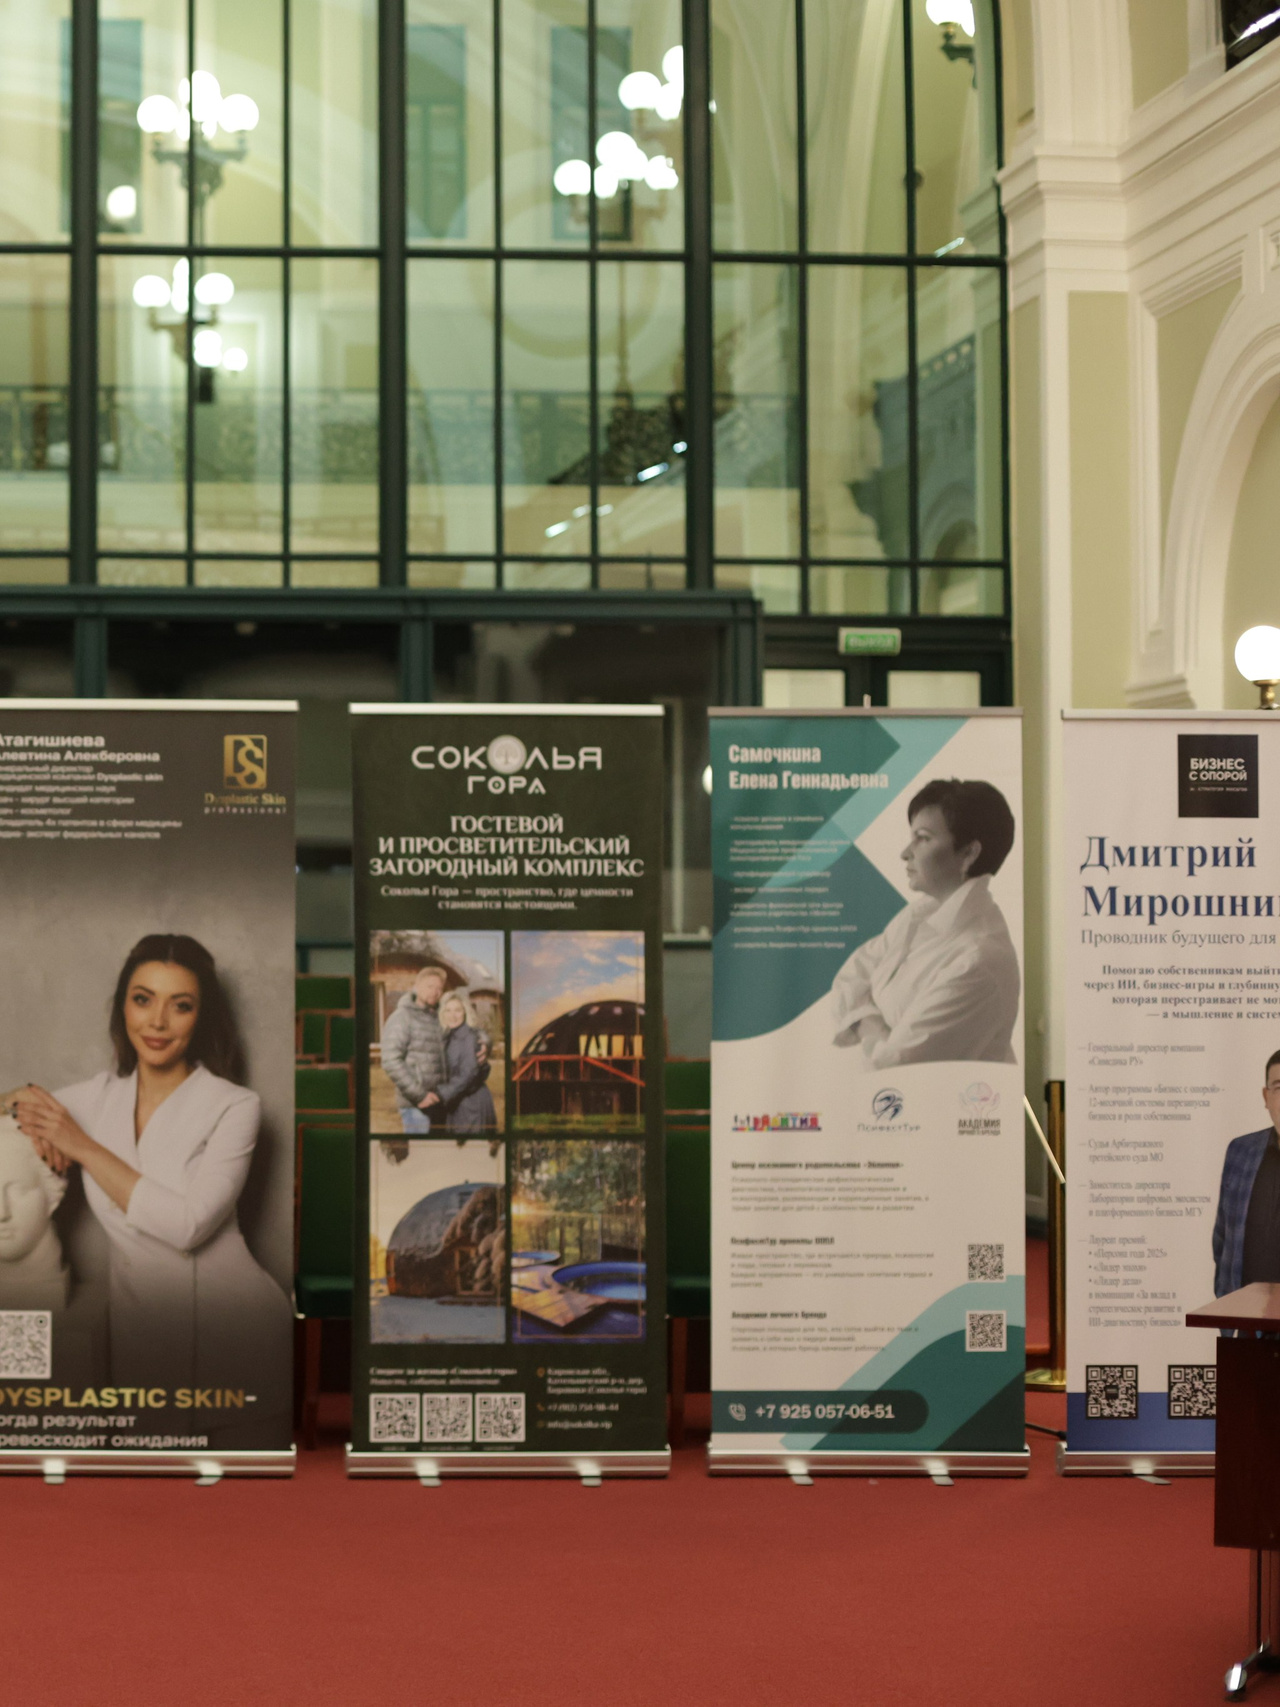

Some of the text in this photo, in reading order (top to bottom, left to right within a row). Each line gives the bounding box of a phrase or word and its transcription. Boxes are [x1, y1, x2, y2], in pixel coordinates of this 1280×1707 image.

[64, 749, 161, 764] Алекберовна
[728, 744, 822, 764] Самочкина
[1190, 757, 1246, 770] БИЗНЕС
[729, 770, 889, 790] Елена Геннадьевна
[1189, 770, 1248, 781] С ОПОРОЙ
[467, 776, 547, 795] ГОРА
[204, 806, 286, 814] professional
[450, 814, 564, 834] ГОСТЕВОЙ
[378, 835, 630, 855] И ПРОСВЕТИТЕЛЬСКИЙ
[1080, 836, 1257, 876] Дмитрий
[369, 857, 645, 878] ЗАГОРОДНЫЙ КОМПЛЕКС
[381, 886, 430, 897] Соколья
[432, 886, 459, 898] Гора
[475, 886, 556, 898] пространство,
[558, 886, 578, 898] где
[580, 886, 633, 898] ценности
[1083, 886, 1280, 926] Мирошни
[1081, 929, 1276, 948] Проводник будущего для
[1102, 965, 1155, 976] Помогаю
[1157, 965, 1243, 976] собственникам
[1084, 982, 1115, 993] через
[1118, 980, 1141, 990] ИИ,
[1143, 980, 1215, 993] бизнес-игры
[1218, 982, 1225, 990] и
[1112, 996, 1280, 1007] которая перестраивает не мо
[1162, 1011, 1169, 1019] а
[1172, 1011, 1234, 1019] мышление
[1236, 1011, 1243, 1019] и
[1246, 1011, 1280, 1019] систе
[958, 1119, 1000, 1129] АКАДЕМИЯ
[755, 1404, 895, 1419] +7 925 057-06-51
[42, 1415, 136, 1429] результат
[111, 1434, 208, 1449] ожидания
